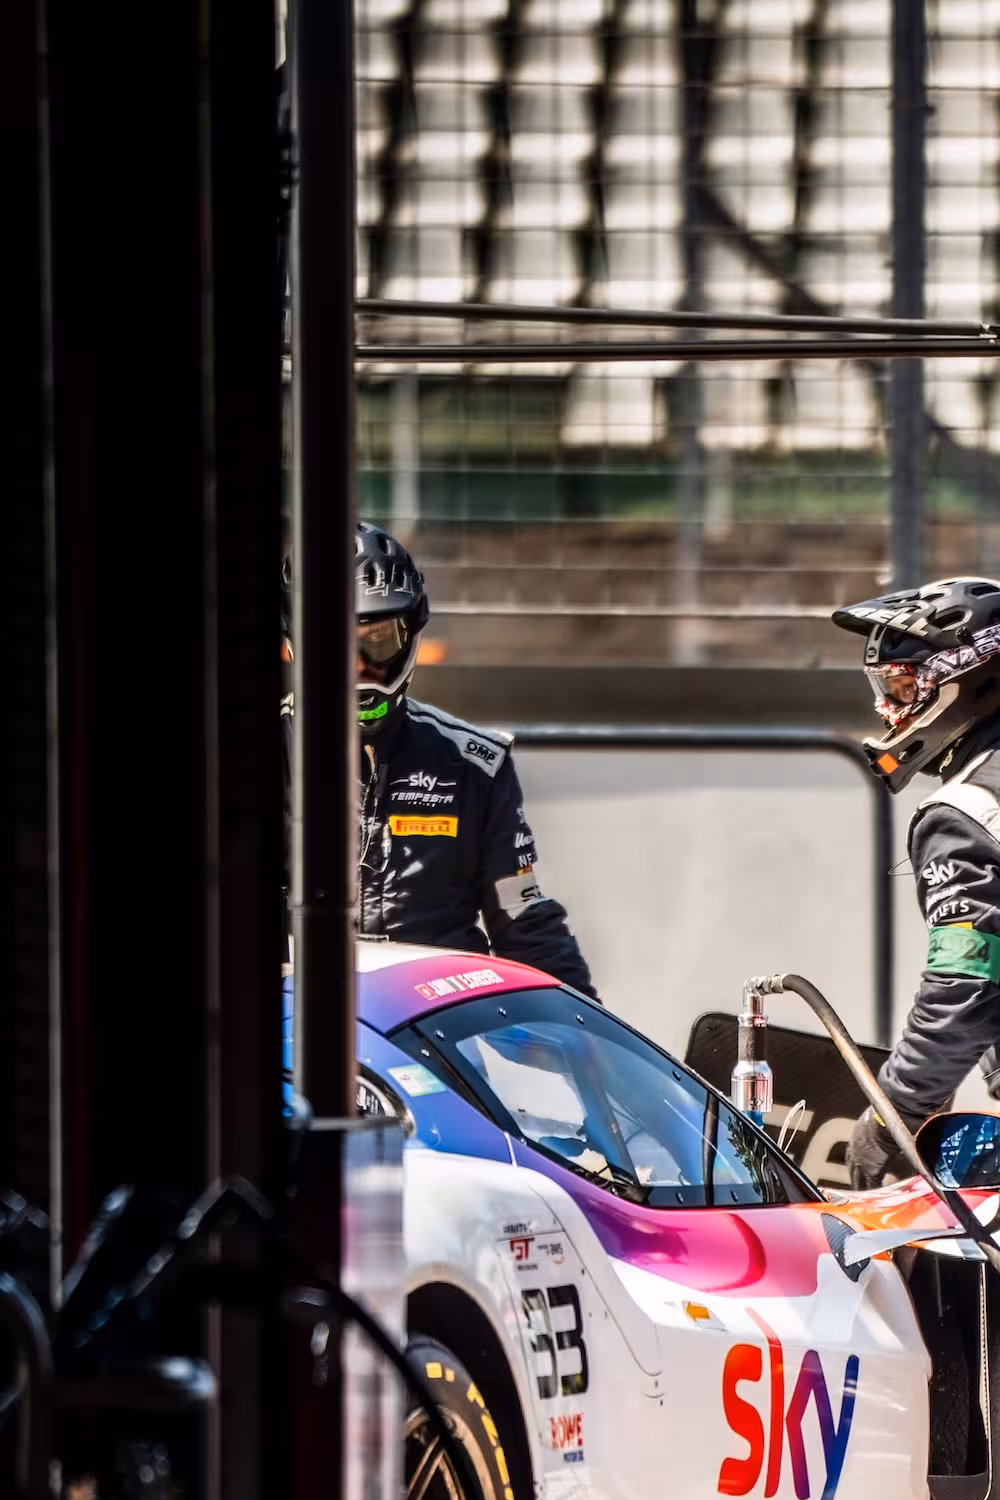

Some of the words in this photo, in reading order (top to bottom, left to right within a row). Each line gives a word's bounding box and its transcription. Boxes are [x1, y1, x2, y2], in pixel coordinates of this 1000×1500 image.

[848, 605, 929, 637] BELL
[466, 740, 496, 763] OMP
[409, 771, 439, 791] sky
[391, 792, 454, 804] TEMPESTA
[396, 820, 451, 833] PIRELLI
[964, 939, 990, 963] 24
